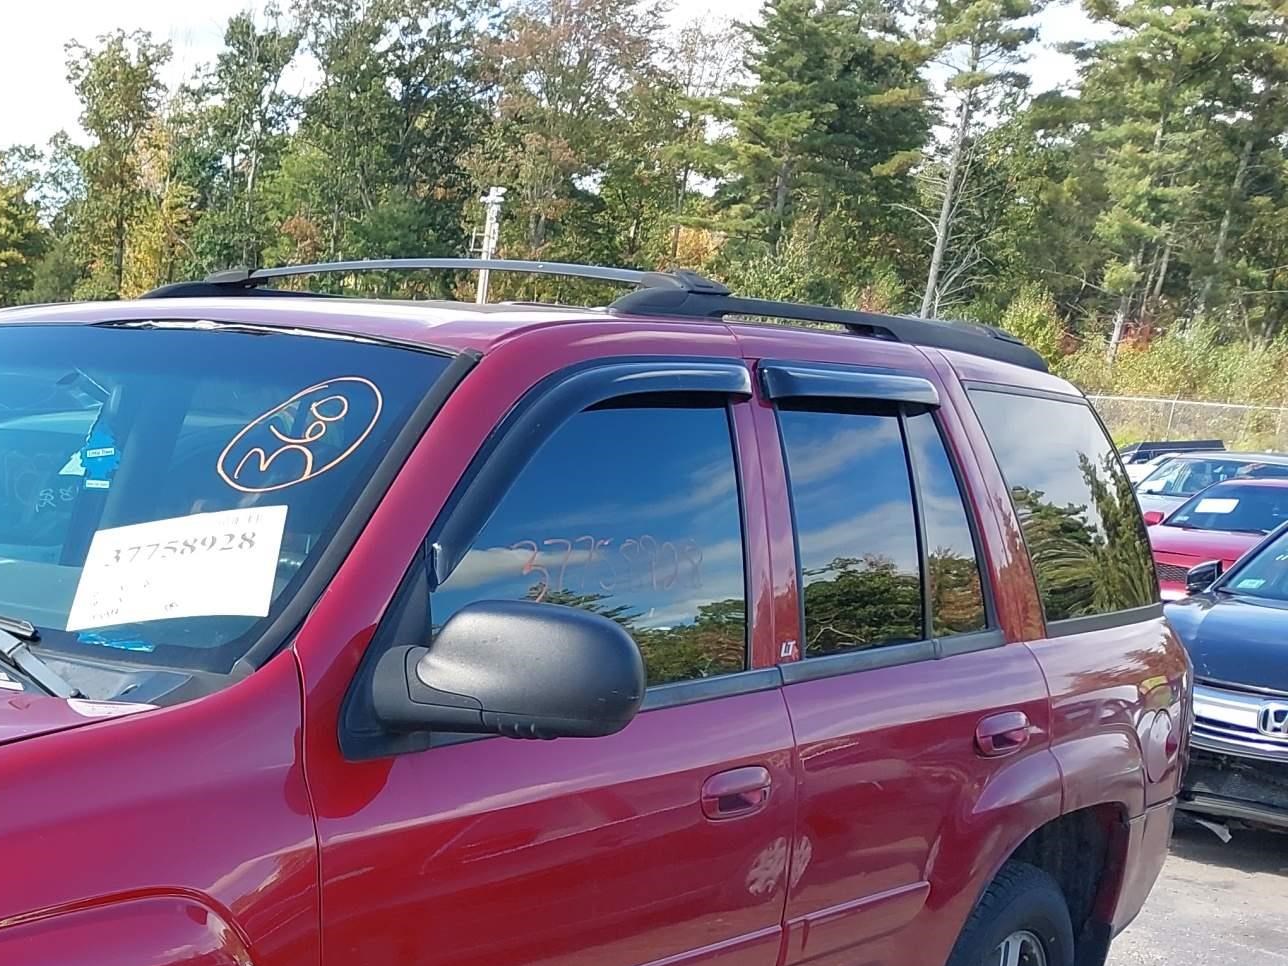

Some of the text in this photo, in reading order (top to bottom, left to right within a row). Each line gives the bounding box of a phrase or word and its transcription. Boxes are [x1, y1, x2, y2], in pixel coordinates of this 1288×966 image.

[233, 395, 349, 480] 360
[104, 531, 257, 567] 37758928
[781, 640, 796, 657] LT
